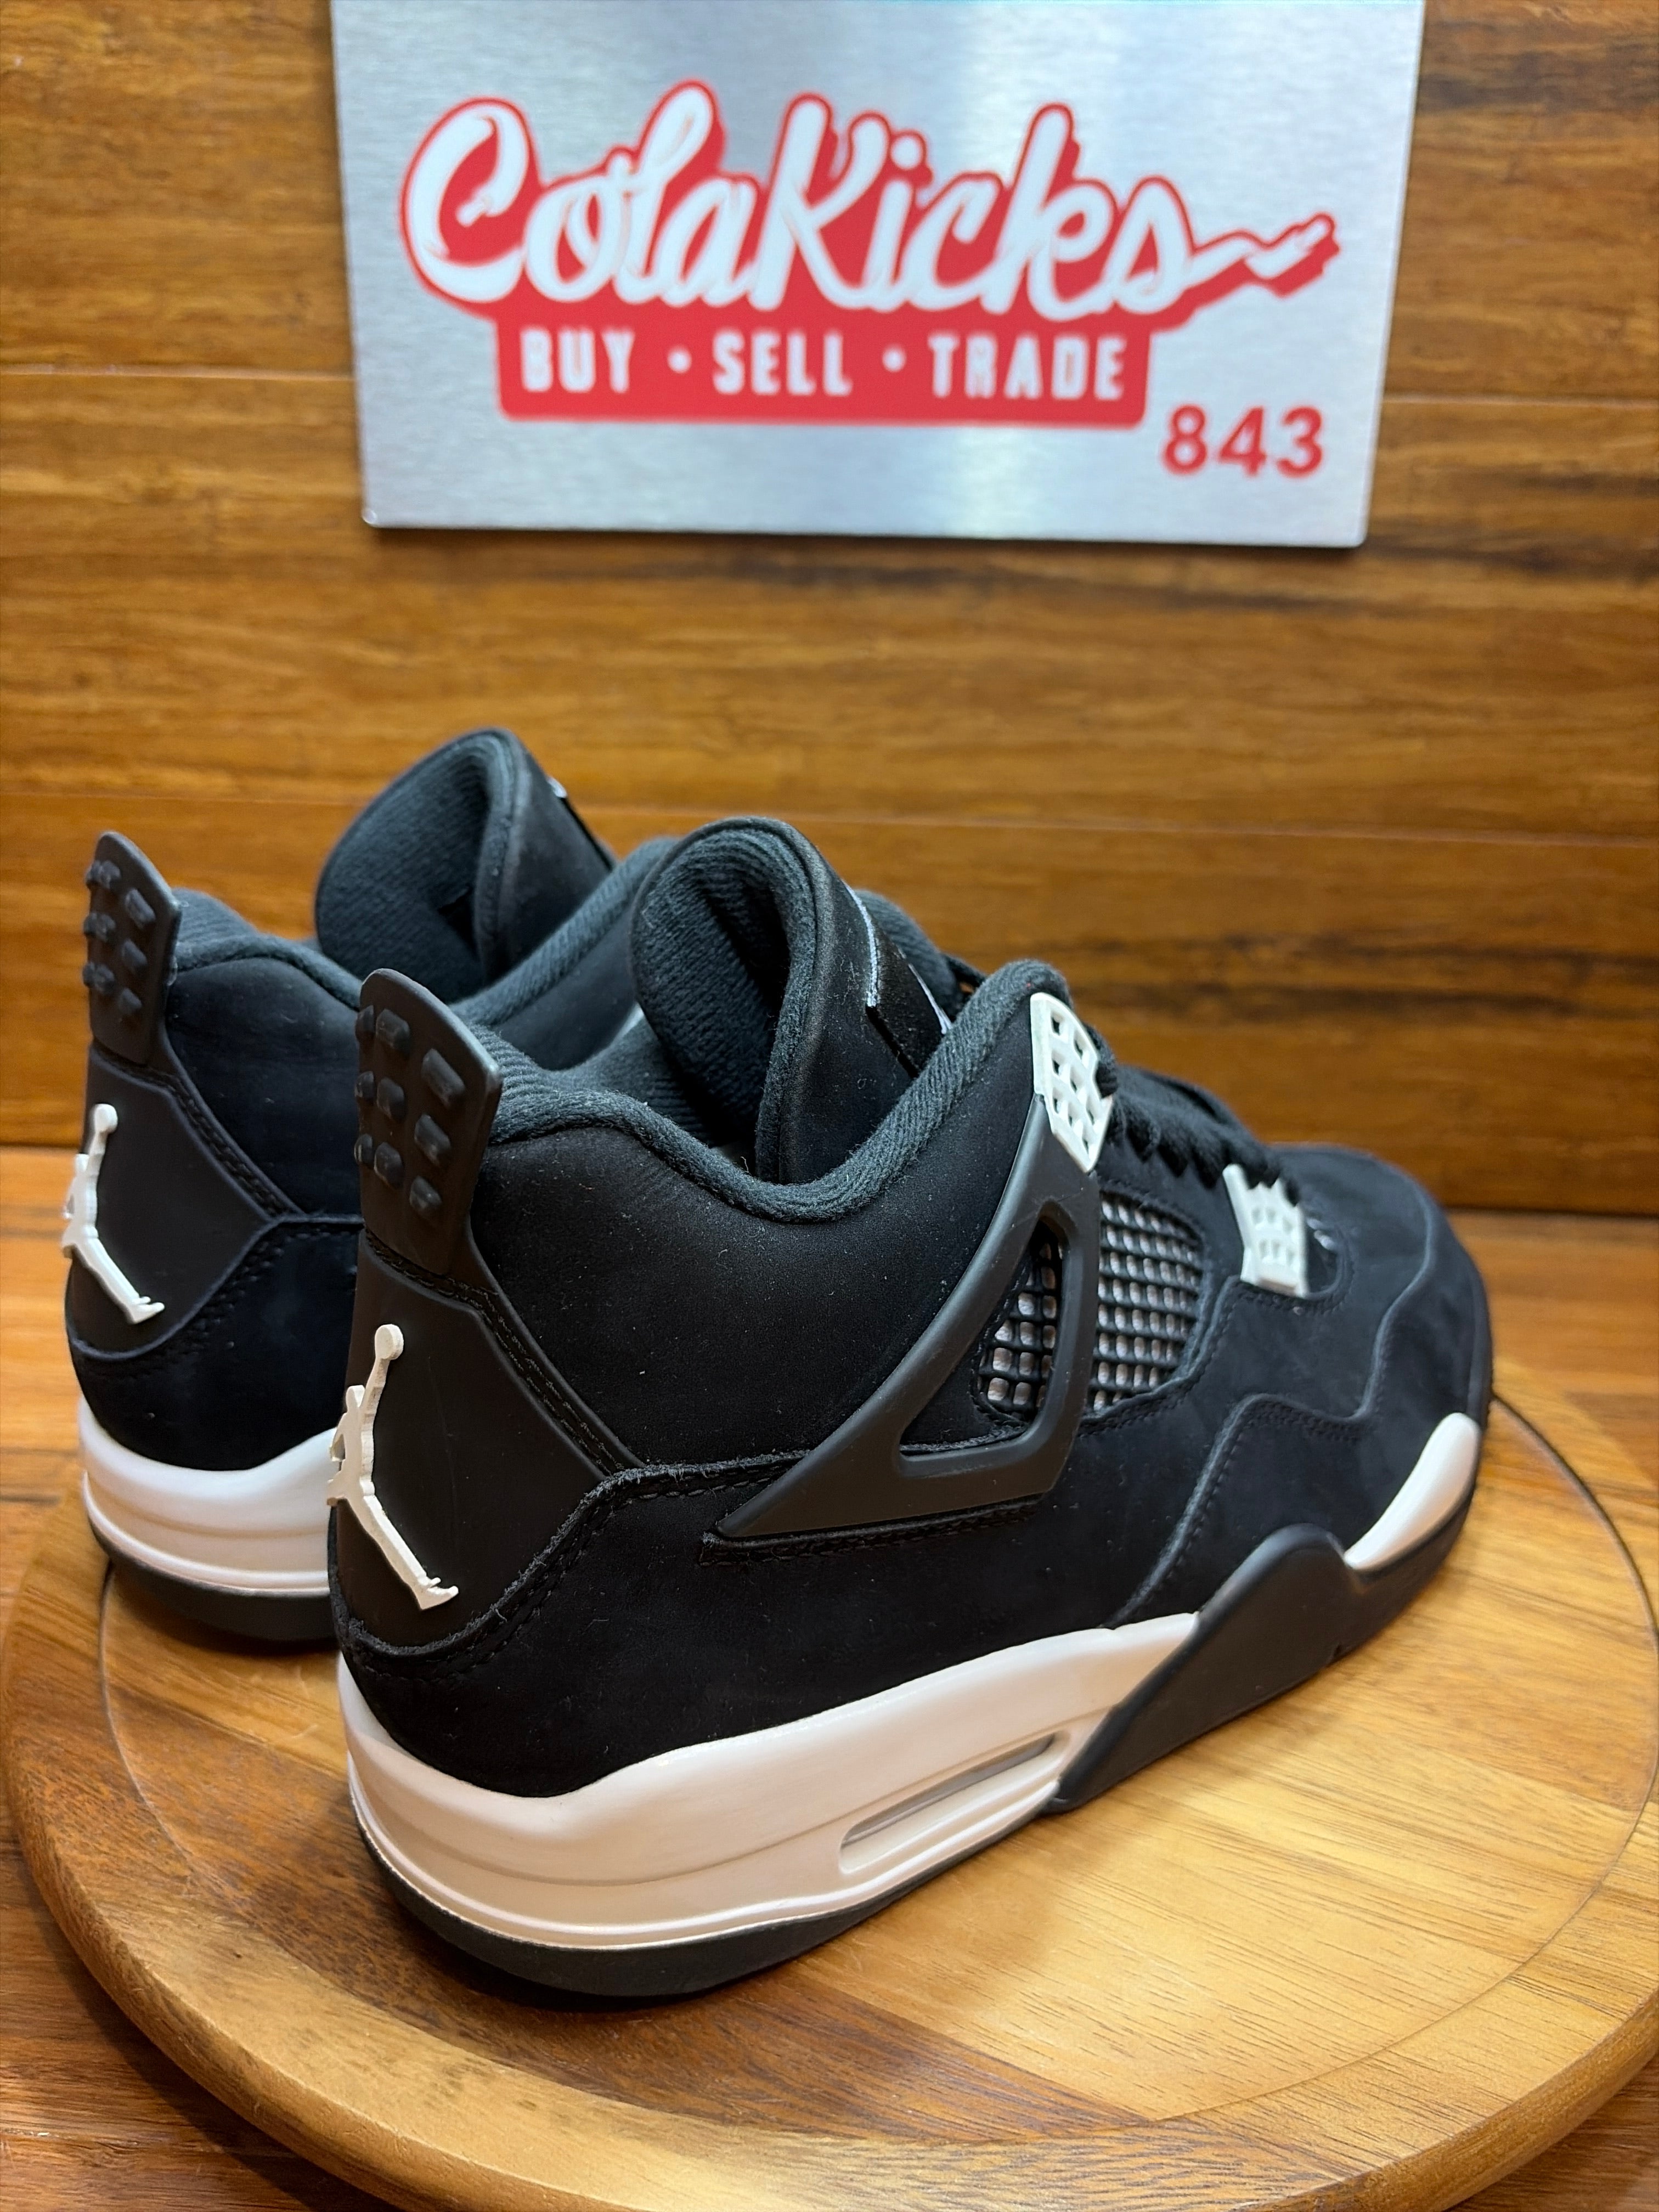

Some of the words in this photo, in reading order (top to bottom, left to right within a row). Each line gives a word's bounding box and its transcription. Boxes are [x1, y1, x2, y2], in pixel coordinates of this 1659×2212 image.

[402, 80, 1338, 321] ColaKicks
[520, 328, 635, 393] BUY
[712, 331, 852, 396] SELL
[927, 335, 1127, 401] TRADE
[1161, 405, 1327, 478] 843
